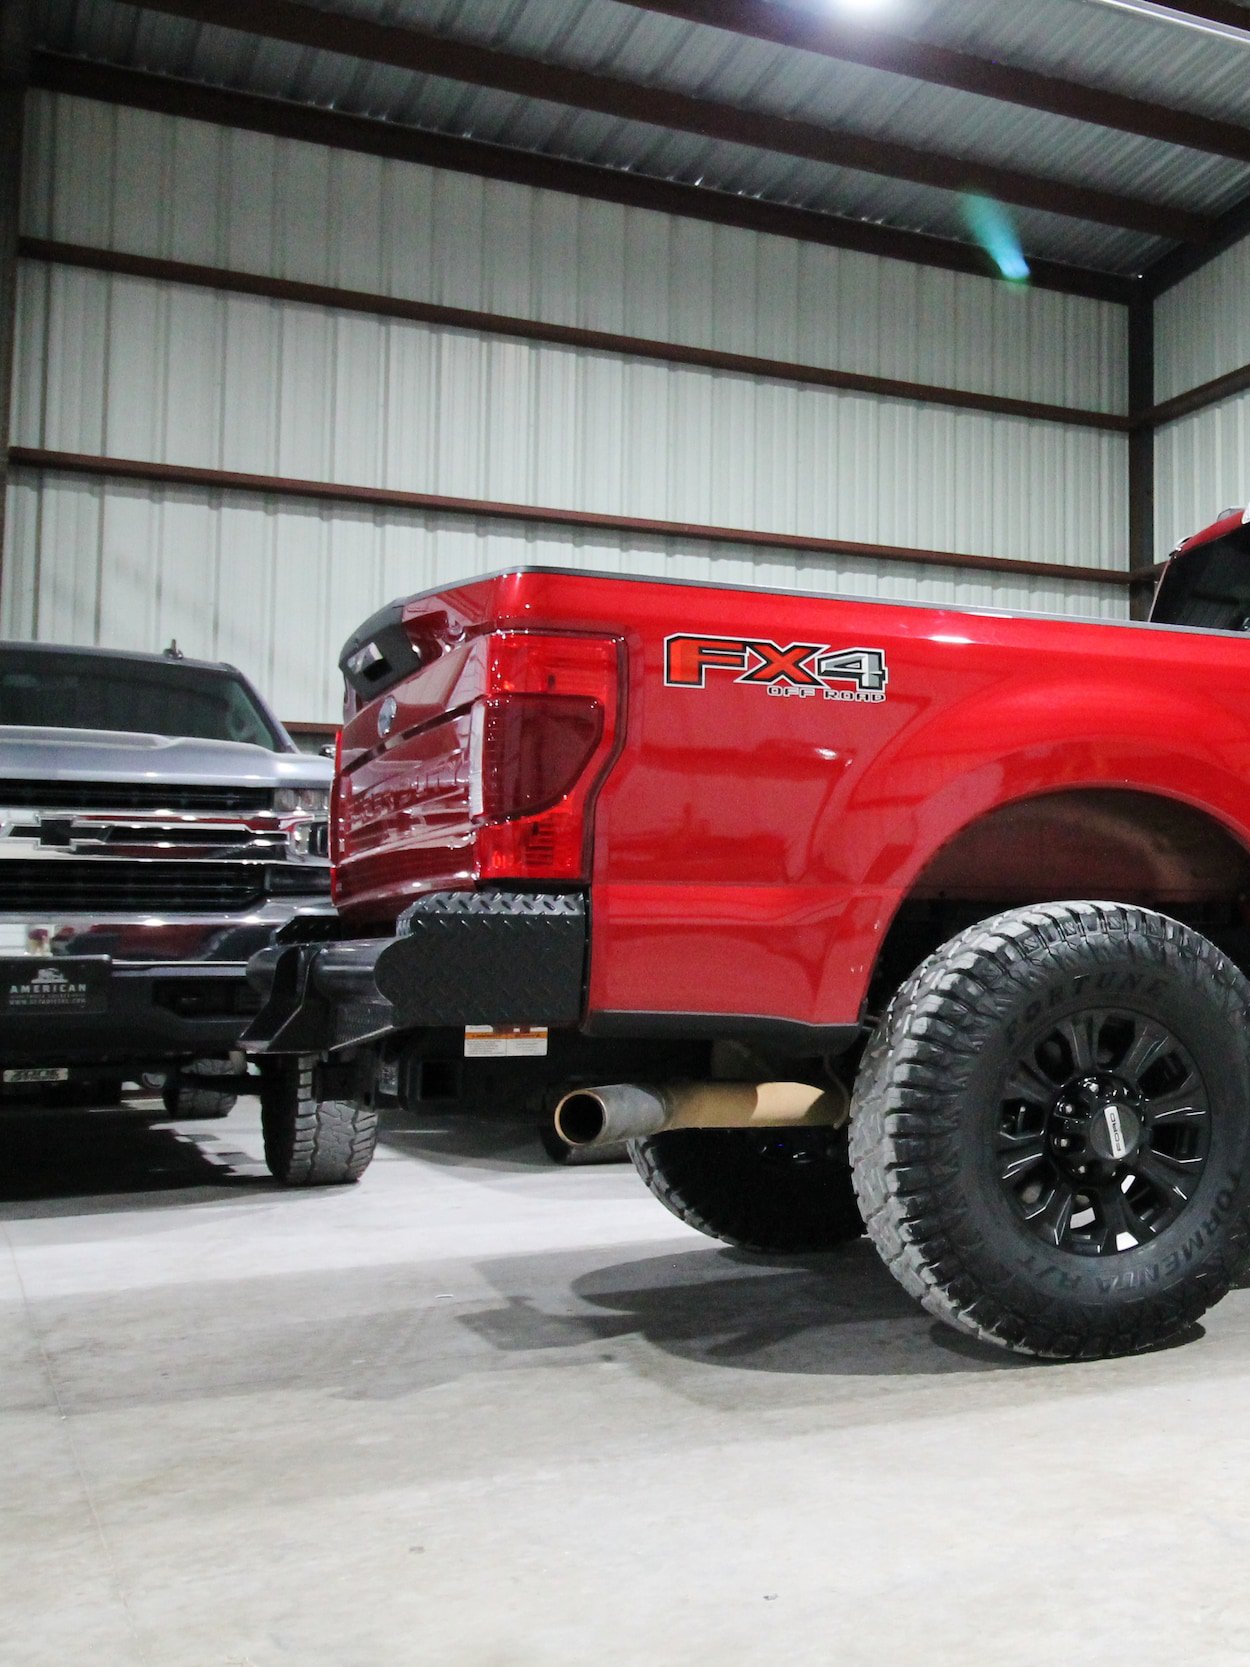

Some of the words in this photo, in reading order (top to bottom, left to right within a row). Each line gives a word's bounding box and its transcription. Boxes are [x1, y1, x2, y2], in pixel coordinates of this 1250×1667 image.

[664, 632, 888, 691] FX4
[767, 686, 816, 697] OFF
[824, 690, 887, 702] ROAD
[10, 984, 87, 993] AMERICAN
